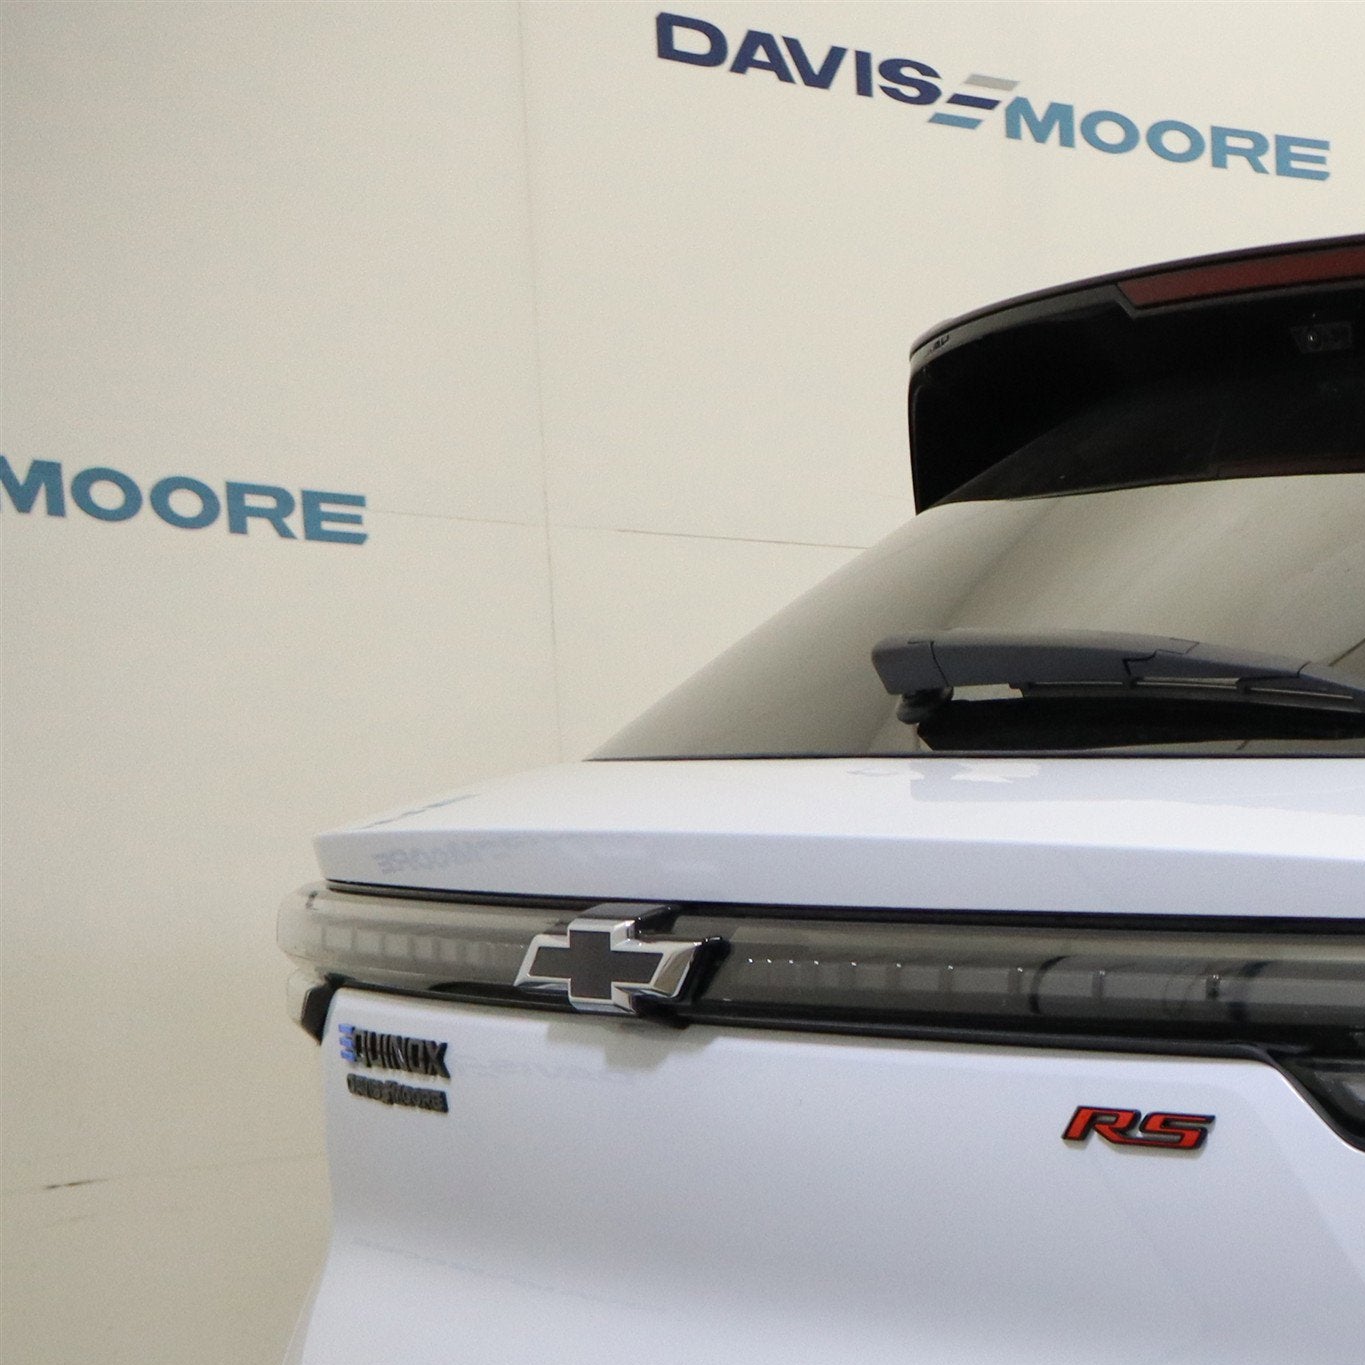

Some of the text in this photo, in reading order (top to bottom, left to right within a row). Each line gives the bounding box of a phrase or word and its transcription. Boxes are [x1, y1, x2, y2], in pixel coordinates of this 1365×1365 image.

[656, 12, 1331, 182] DAVIS MOORE
[0, 454, 367, 545] MOORE
[1061, 1106, 1216, 1150] RS
